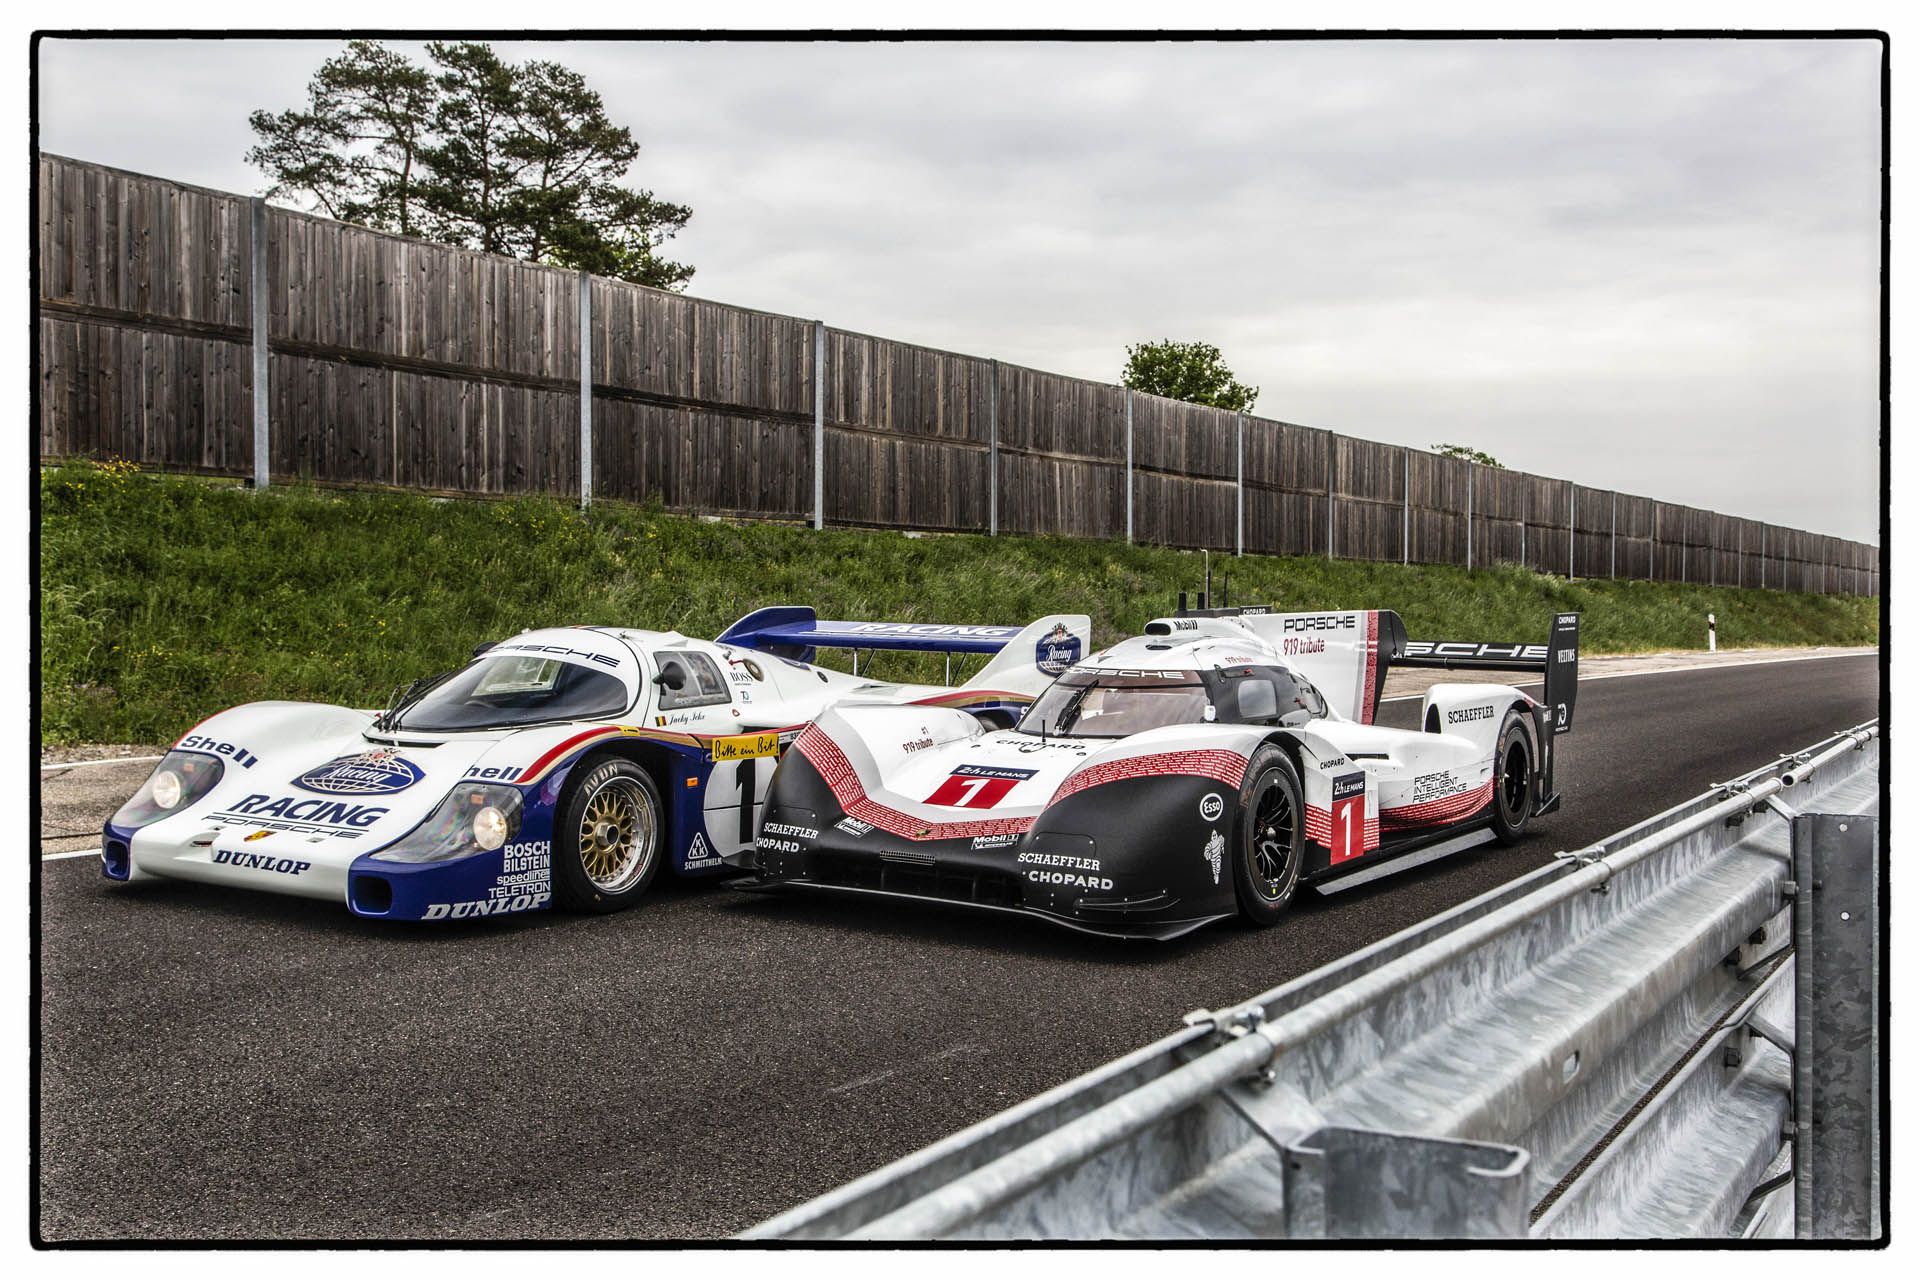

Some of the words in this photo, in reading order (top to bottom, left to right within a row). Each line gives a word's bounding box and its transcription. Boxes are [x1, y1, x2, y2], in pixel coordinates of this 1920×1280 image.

[851, 623, 1014, 636] RACING
[1284, 616, 1355, 632] PORSCHE
[1558, 615, 1576, 625] CHOPARD
[1046, 644, 1072, 663] Racing
[1283, 637, 1298, 656] 919
[1299, 636, 1325, 655] tribute
[730, 671, 753, 682] BOSS
[669, 713, 688, 726] Jacky
[1447, 705, 1495, 724] SCHAEFFLER
[181, 735, 259, 769] Shell
[715, 740, 737, 759] Bitte
[740, 745, 755, 755] ein
[758, 736, 779, 754] Bit!
[902, 741, 916, 754] 919
[915, 738, 934, 751] tribute
[1320, 757, 1345, 770] CHOPARD
[320, 764, 392, 784] Racing
[583, 763, 619, 797] AVON
[1414, 770, 1450, 786] PORSCHE
[952, 778, 991, 807] 1
[1350, 781, 1364, 792] MANS
[1413, 783, 1467, 803] PERFORMANCE
[1414, 777, 1458, 795] INTELLIGENT
[226, 794, 391, 827] RACING
[736, 758, 755, 845] 1
[1203, 801, 1221, 814] Esso
[201, 815, 364, 840] PORSCHE
[763, 822, 819, 840] SCHAEFFLER
[1340, 802, 1352, 857] 1
[756, 837, 800, 853] CHOPARD
[973, 834, 1006, 843] Mobil
[504, 840, 551, 859] BOSCH
[213, 849, 311, 875] DUNLOP
[503, 854, 550, 873] BILSTEIN
[1017, 852, 1100, 871] SCHAEFFLER
[496, 869, 549, 886] speedline
[1028, 870, 1114, 890] CHOPARD
[488, 881, 551, 899] TELETRON
[421, 892, 552, 920] DUNLOP
